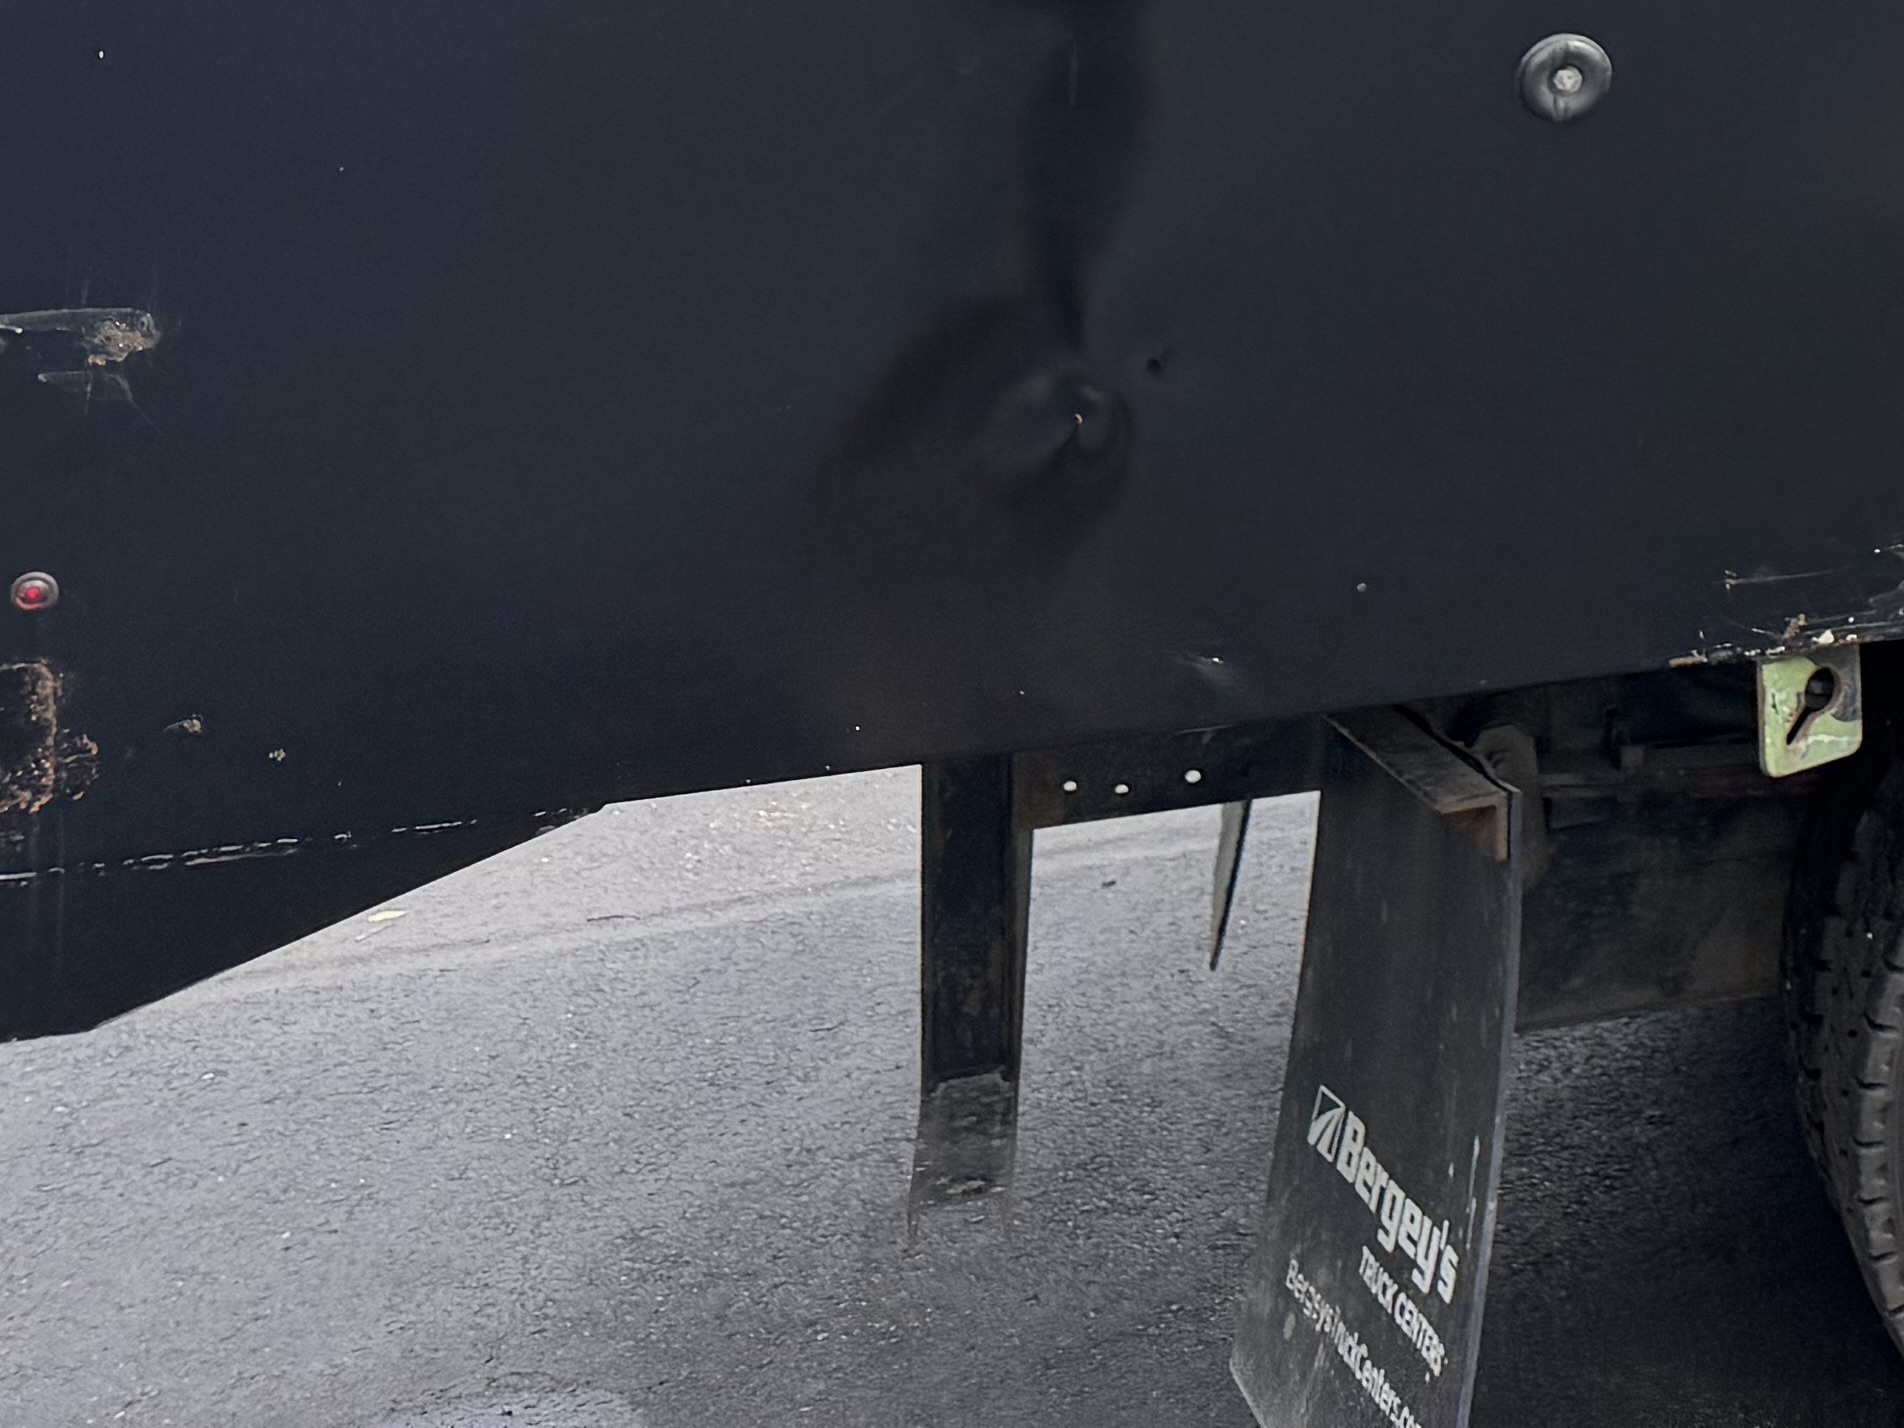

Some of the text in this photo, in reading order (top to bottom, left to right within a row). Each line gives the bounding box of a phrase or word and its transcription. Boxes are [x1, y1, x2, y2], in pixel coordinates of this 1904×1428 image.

[1337, 1111, 1460, 1304] Bergey's
[1359, 1245, 1446, 1377] TRUCK CENTERS
